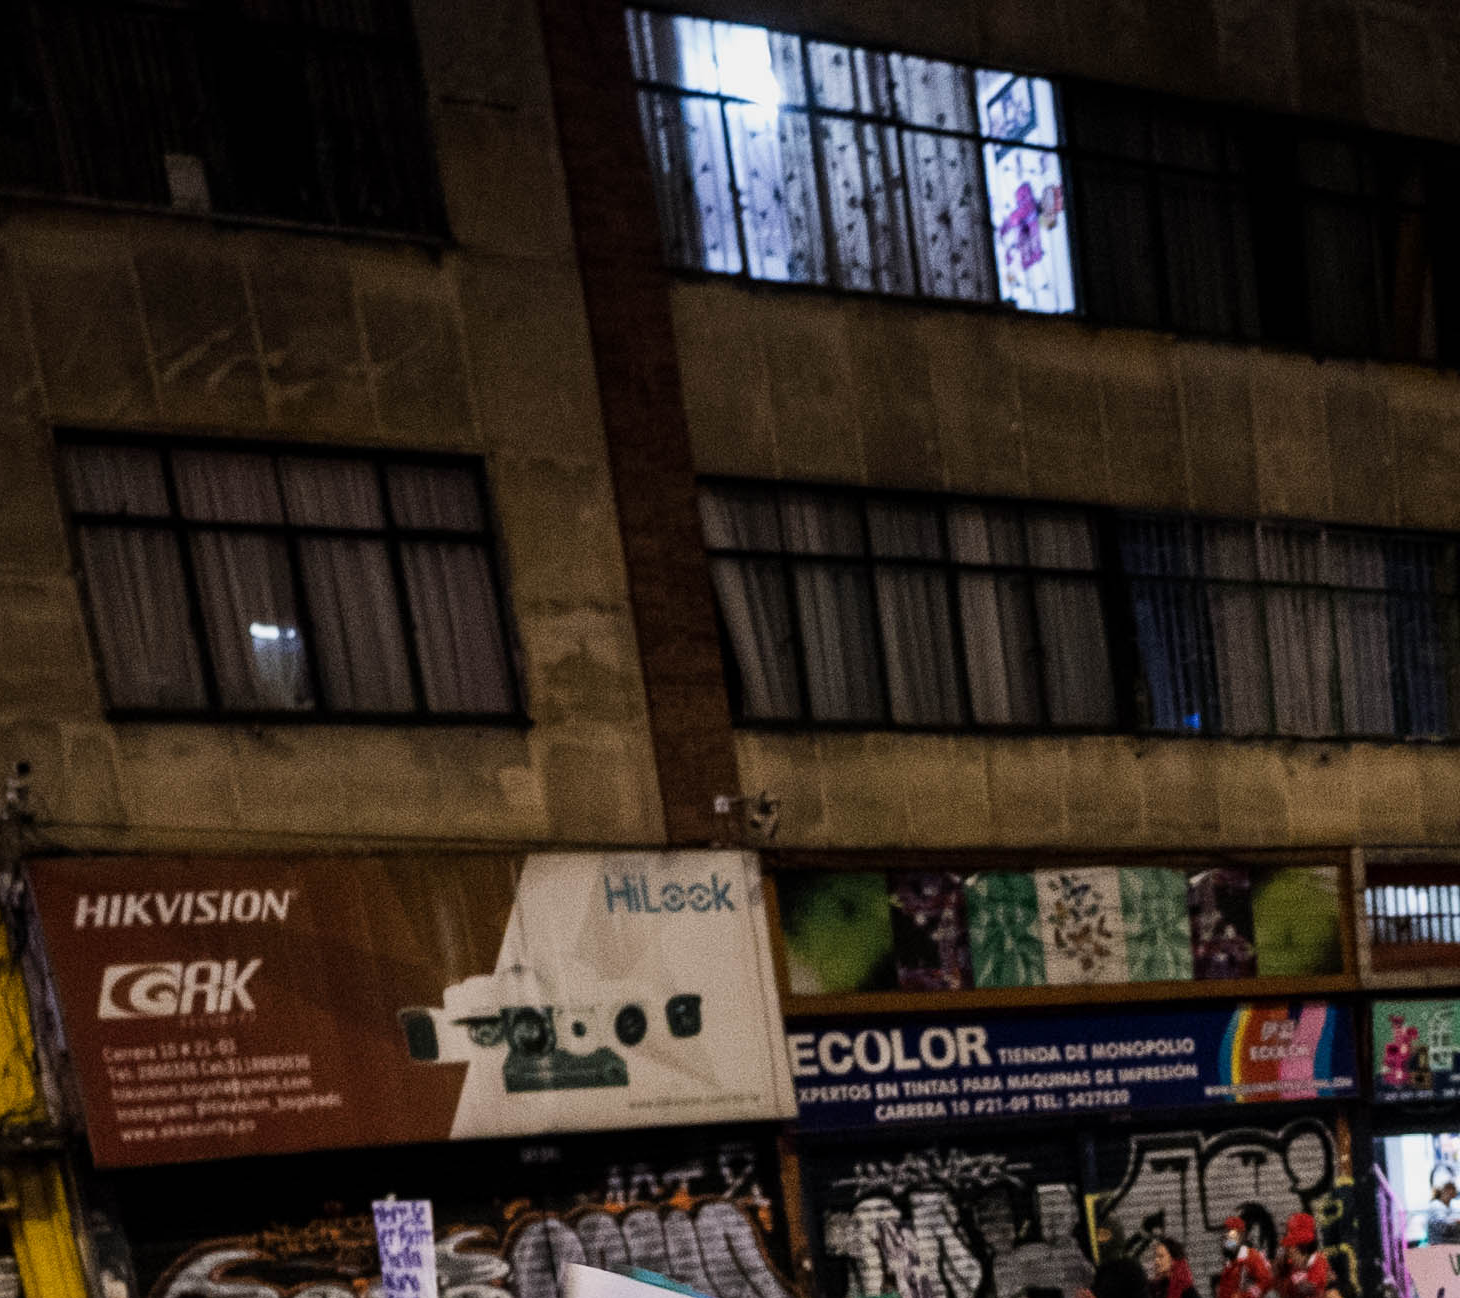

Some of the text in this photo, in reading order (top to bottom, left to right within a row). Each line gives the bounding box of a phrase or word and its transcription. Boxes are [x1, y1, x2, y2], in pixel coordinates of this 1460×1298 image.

[75, 889, 290, 931] HIKVISION
[602, 874, 736, 915] HiLook
[787, 1025, 1197, 1078] ECOLOR TIENDA DE MONOPOLIO
[796, 1083, 873, 1105] XPERTOS
[875, 1081, 900, 1100] EN
[903, 1078, 960, 1099] TINTAS
[962, 1074, 1005, 1094] PARA
[1095, 1067, 1116, 1085] DE
[874, 1100, 948, 1122] CARRERA
